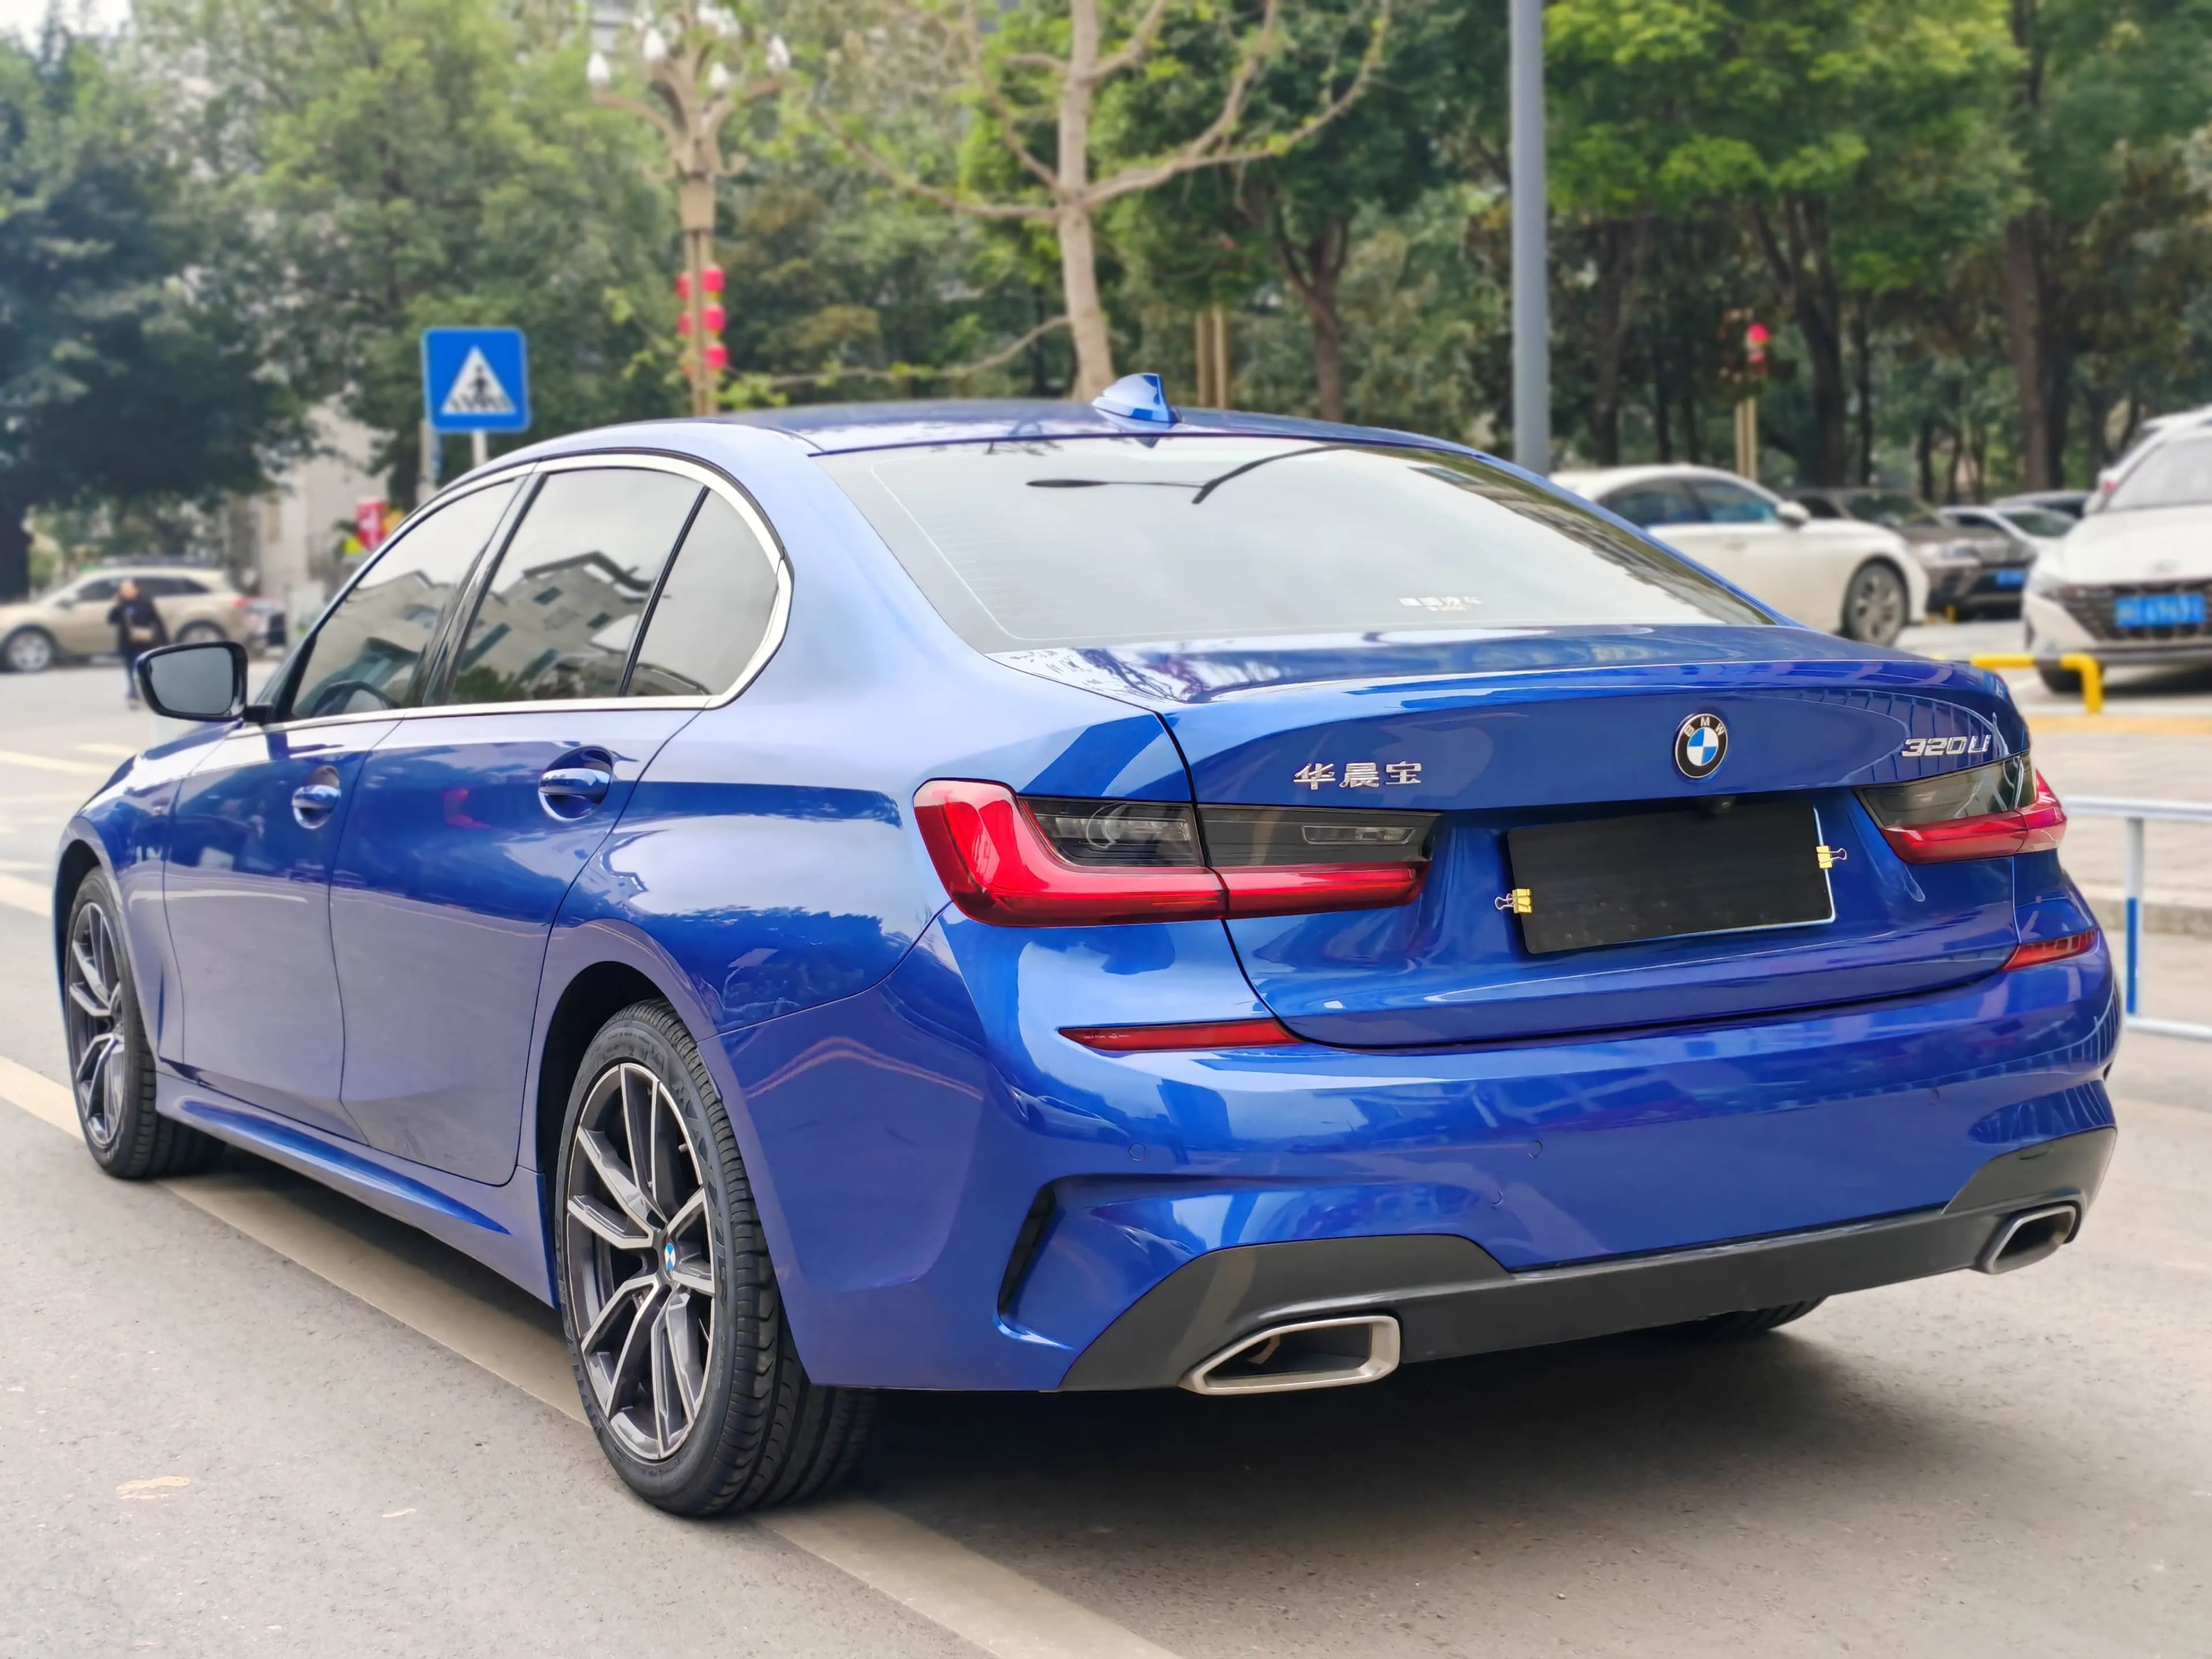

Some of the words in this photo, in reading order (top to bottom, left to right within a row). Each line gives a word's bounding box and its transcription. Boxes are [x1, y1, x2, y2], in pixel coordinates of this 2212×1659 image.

[1683, 716, 1725, 737] BMW
[1293, 760, 1422, 790] 华晨宝
